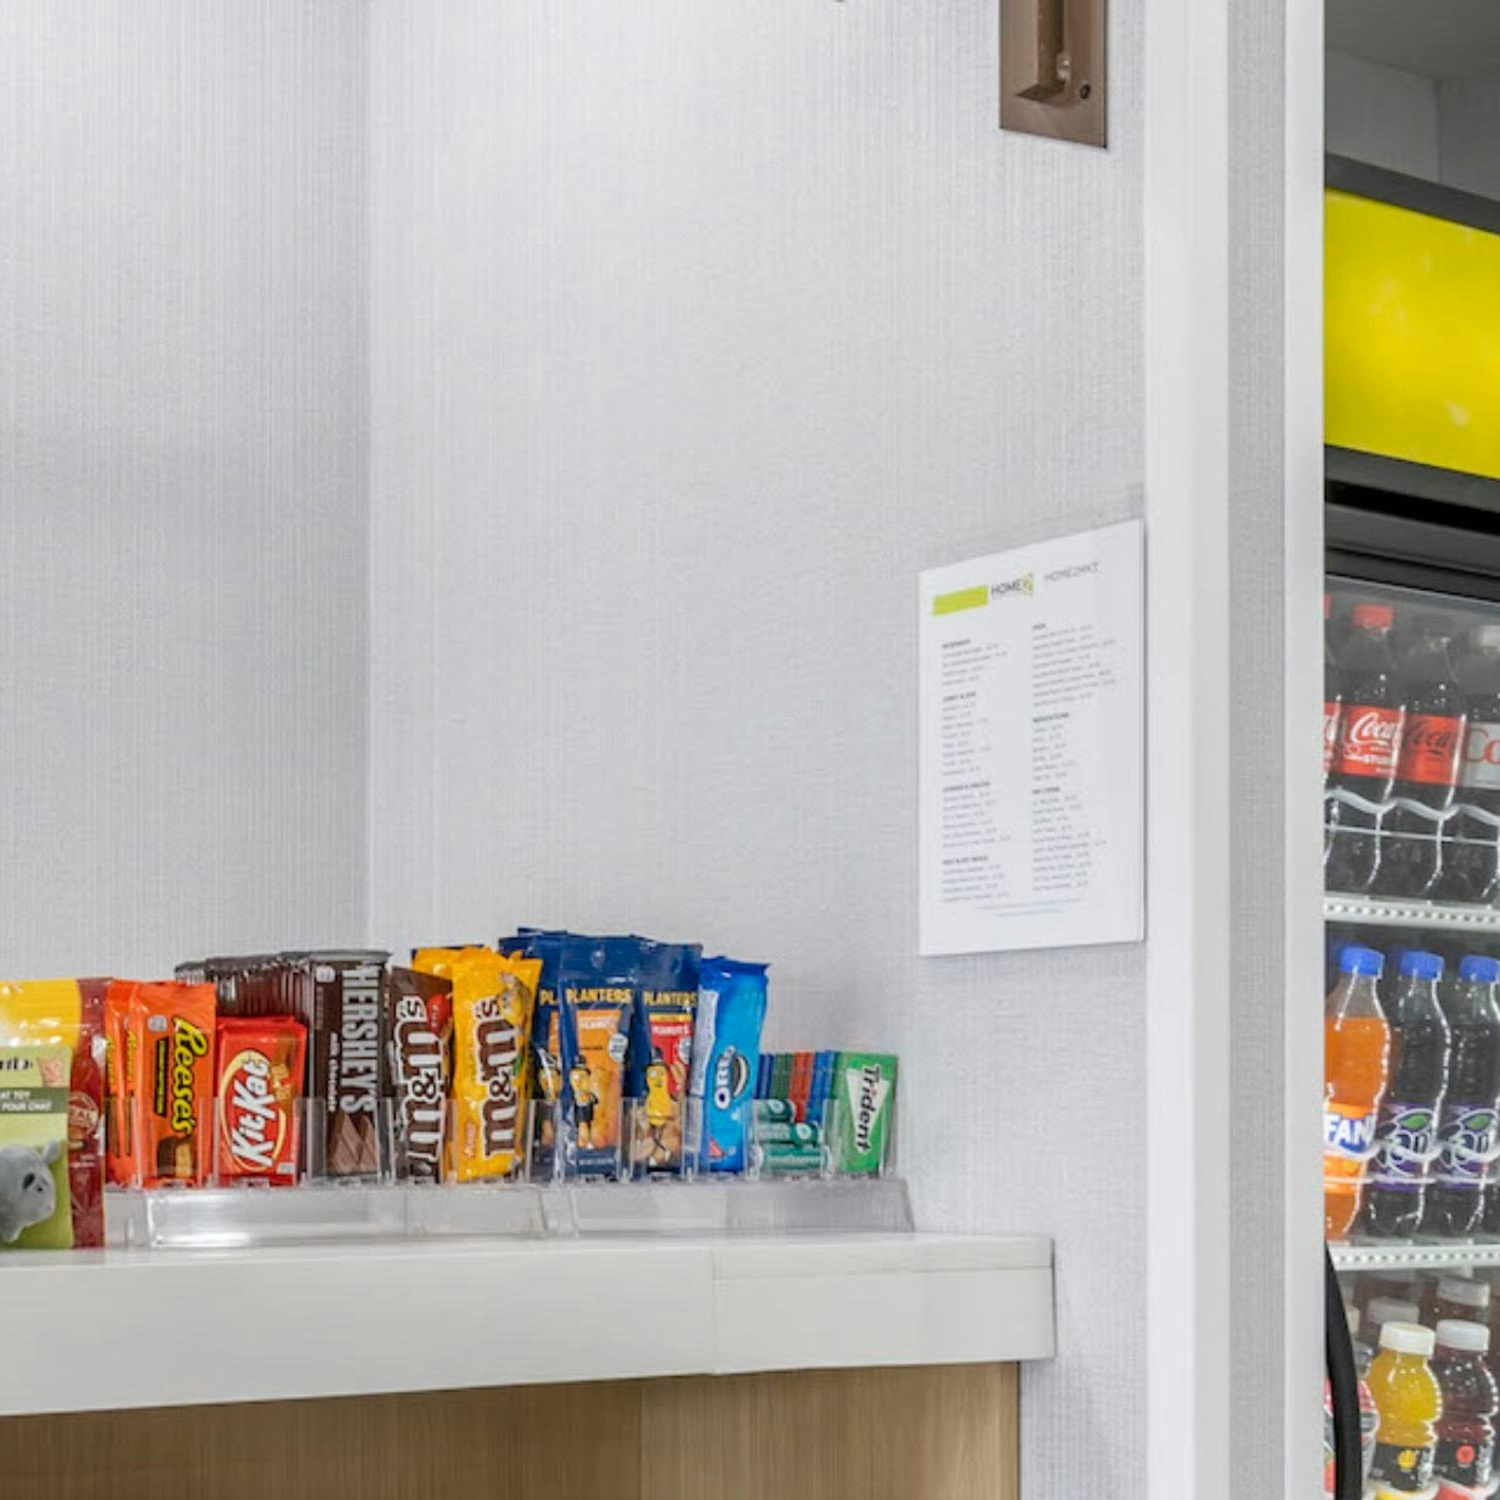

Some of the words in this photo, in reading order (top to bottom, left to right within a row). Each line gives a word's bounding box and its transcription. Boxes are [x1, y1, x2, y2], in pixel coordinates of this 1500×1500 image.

[566, 988, 632, 1004] PLANTERS
[642, 991, 697, 1007] PLANTERS
[339, 965, 381, 1114] HERSHEY'S
[173, 1017, 208, 1137] Reese's
[13, 1091, 30, 1100] TOY
[857, 1063, 882, 1155] Trident
[1325, 1113, 1373, 1147] FAN
